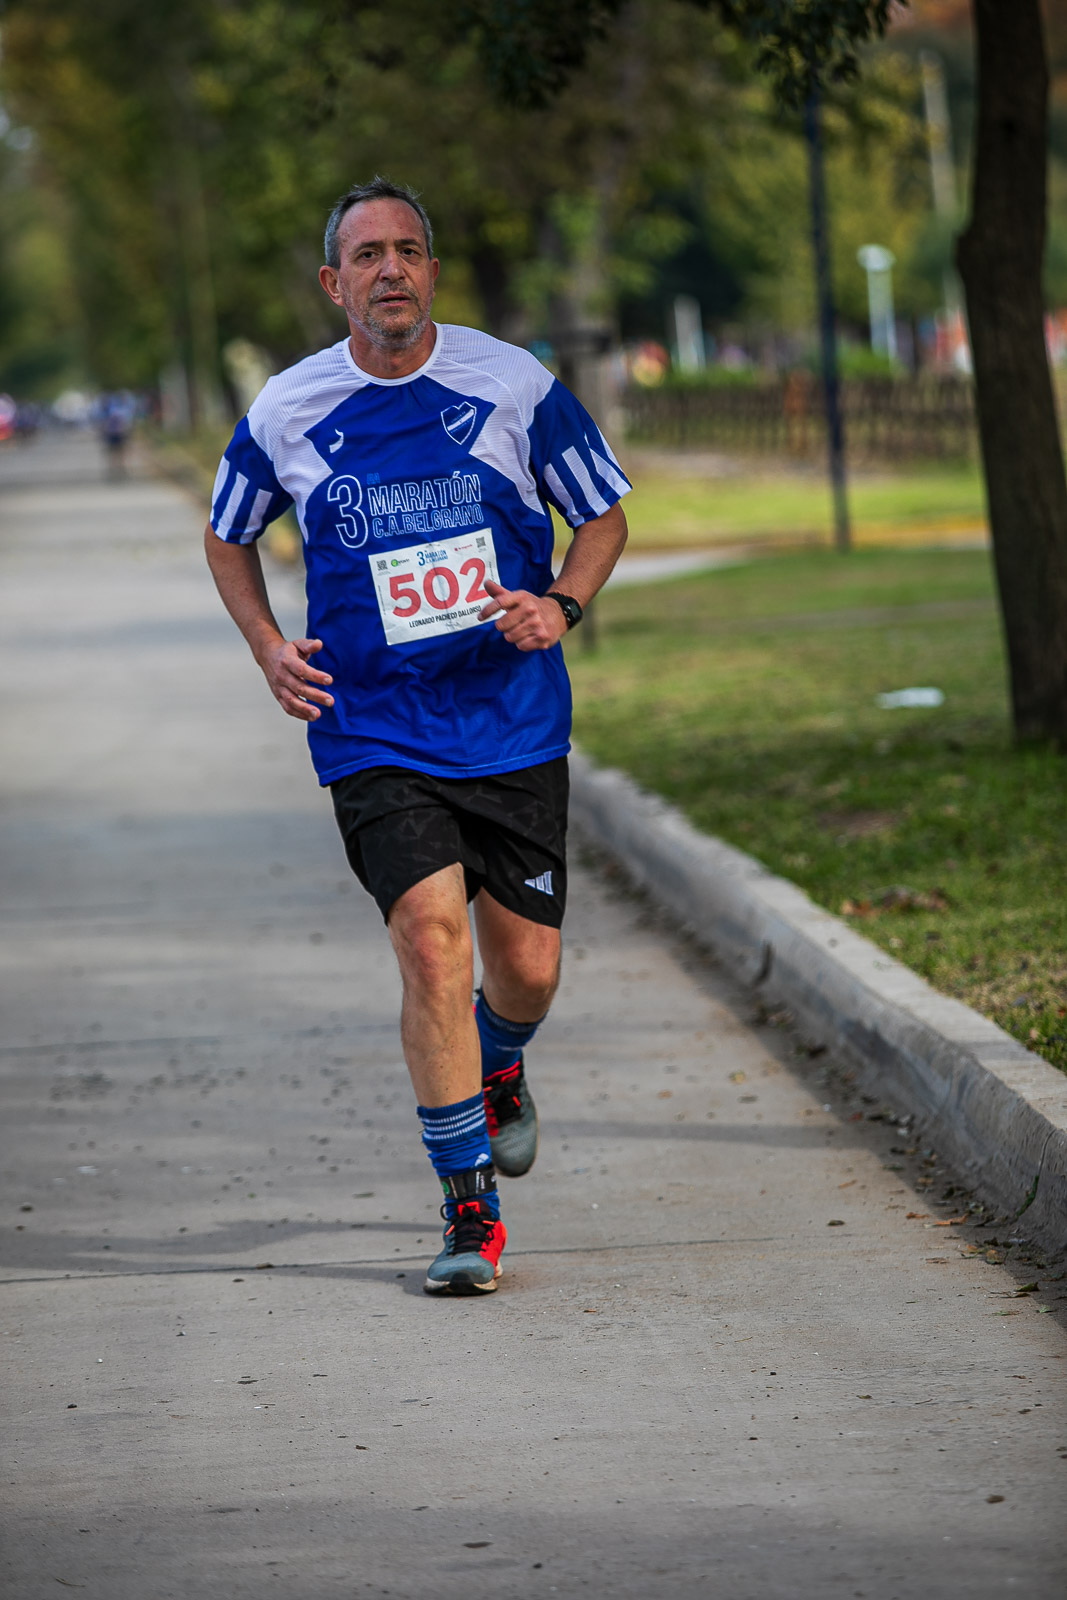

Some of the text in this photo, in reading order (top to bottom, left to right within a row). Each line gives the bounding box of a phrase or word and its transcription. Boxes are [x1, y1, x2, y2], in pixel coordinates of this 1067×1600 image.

[327, 474, 369, 549] 3
[367, 471, 482, 516] MARATÓN
[416, 551, 426, 567] 3
[389, 557, 490, 618] 502
[409, 616, 435, 628] LEONARDO
[435, 611, 458, 623] PACHECO
